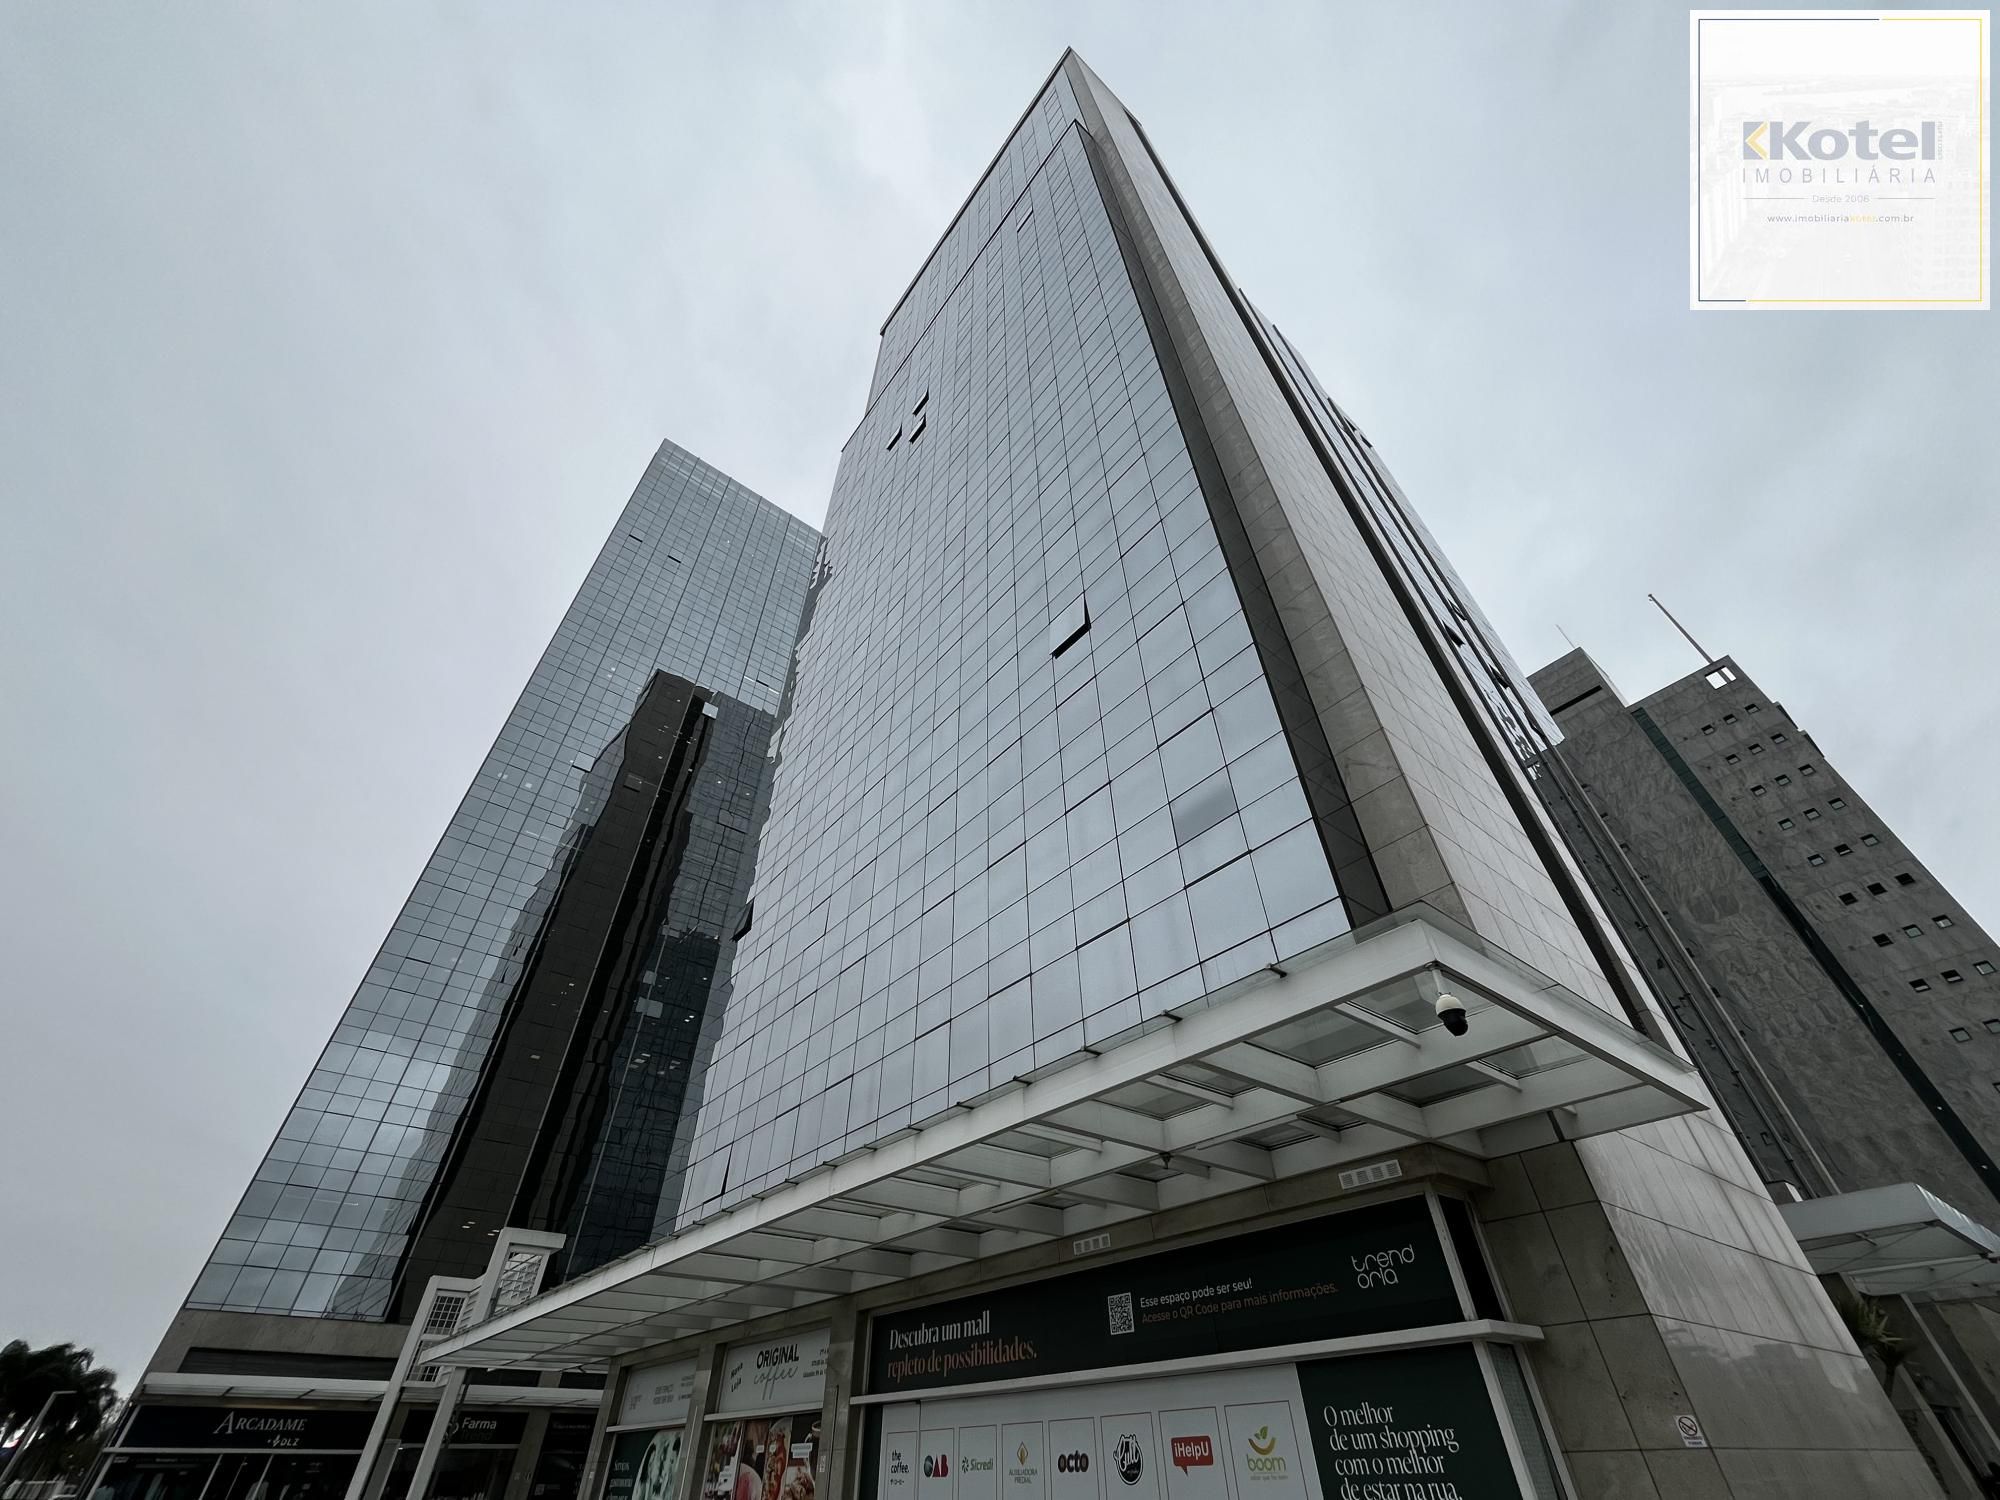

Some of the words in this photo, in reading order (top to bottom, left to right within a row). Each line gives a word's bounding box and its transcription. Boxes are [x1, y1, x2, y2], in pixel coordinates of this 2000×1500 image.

[1351, 1243, 1415, 1272] trend
[1357, 1267, 1399, 1289] orla
[1140, 1296, 1159, 1309] Esse
[1160, 1291, 1190, 1307] espaço
[1191, 1285, 1215, 1301] pode
[1216, 1283, 1230, 1295] ser
[1232, 1277, 1253, 1292] seu!
[1142, 1310, 1171, 1324] Acesse
[1172, 1309, 1178, 1319] o
[1179, 1306, 1193, 1320] QR
[1195, 1301, 1219, 1315] Code
[1220, 1299, 1241, 1314] para
[1243, 1295, 1268, 1307] mais
[1269, 1281, 1339, 1304] informações.
[889, 1322, 939, 1351] Descubra
[941, 1322, 961, 1341] um
[963, 1308, 990, 1338] mall
[756, 1344, 799, 1369] ORIGINAL
[887, 1352, 925, 1384] repleto
[927, 1349, 942, 1374] de
[943, 1335, 1038, 1378] possibilidades.
[212, 1411, 306, 1434] ARCADAME
[462, 1416, 497, 1430] Farma
[1323, 1405, 1338, 1427] O
[1340, 1401, 1394, 1426] melhor
[1174, 1441, 1209, 1460] iHelpU
[1330, 1428, 1349, 1451] de
[1350, 1432, 1378, 1450] um
[1379, 1424, 1460, 1454] shopping
[892, 1449, 902, 1461] the
[923, 1454, 949, 1478] OAB
[970, 1458, 994, 1471] Sicredi
[1058, 1450, 1089, 1473] octo
[1246, 1454, 1286, 1472] boom
[1335, 1457, 1370, 1476] com
[1372, 1457, 1384, 1475] o
[1386, 1449, 1446, 1475] melhor
[1341, 1477, 1360, 1500] de
[1363, 1481, 1401, 1500] estar
[1404, 1482, 1426, 1500] na
